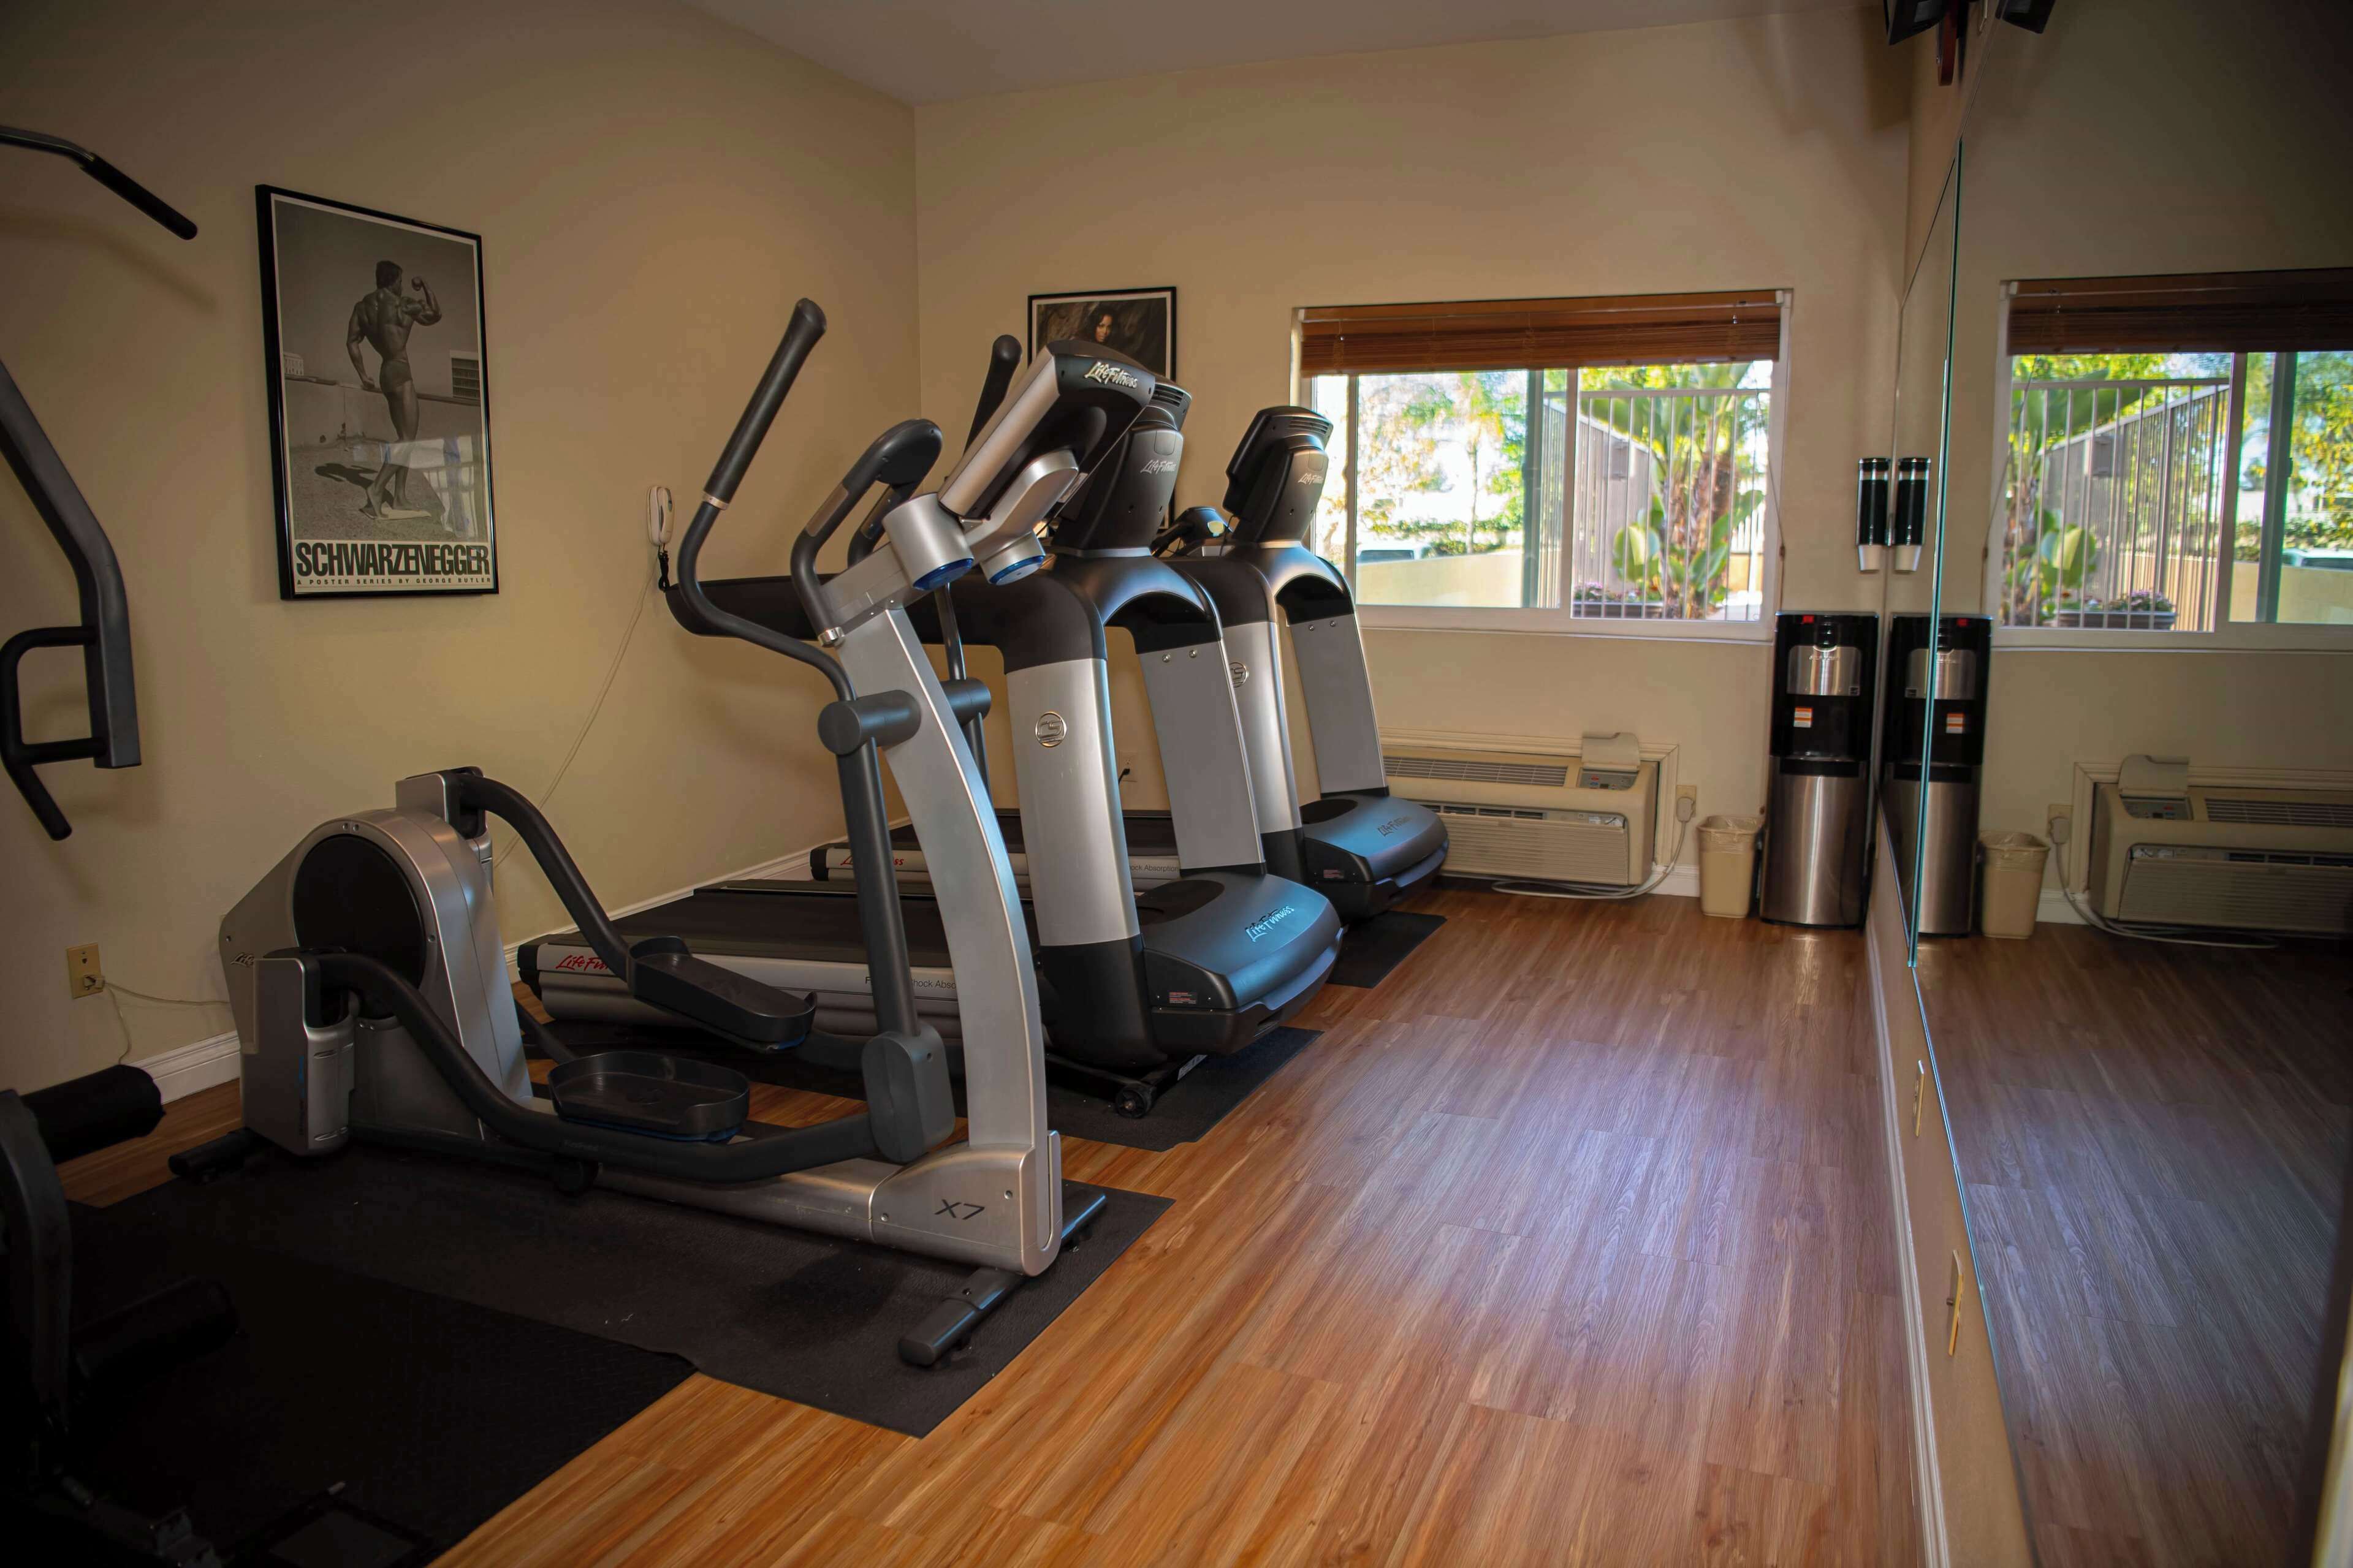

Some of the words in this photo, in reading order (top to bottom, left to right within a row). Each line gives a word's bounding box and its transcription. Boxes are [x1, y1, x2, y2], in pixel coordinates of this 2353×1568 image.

[295, 542, 490, 577] SCHWARZENEGGER
[913, 979, 933, 988] hock
[935, 1199, 985, 1220] X7
